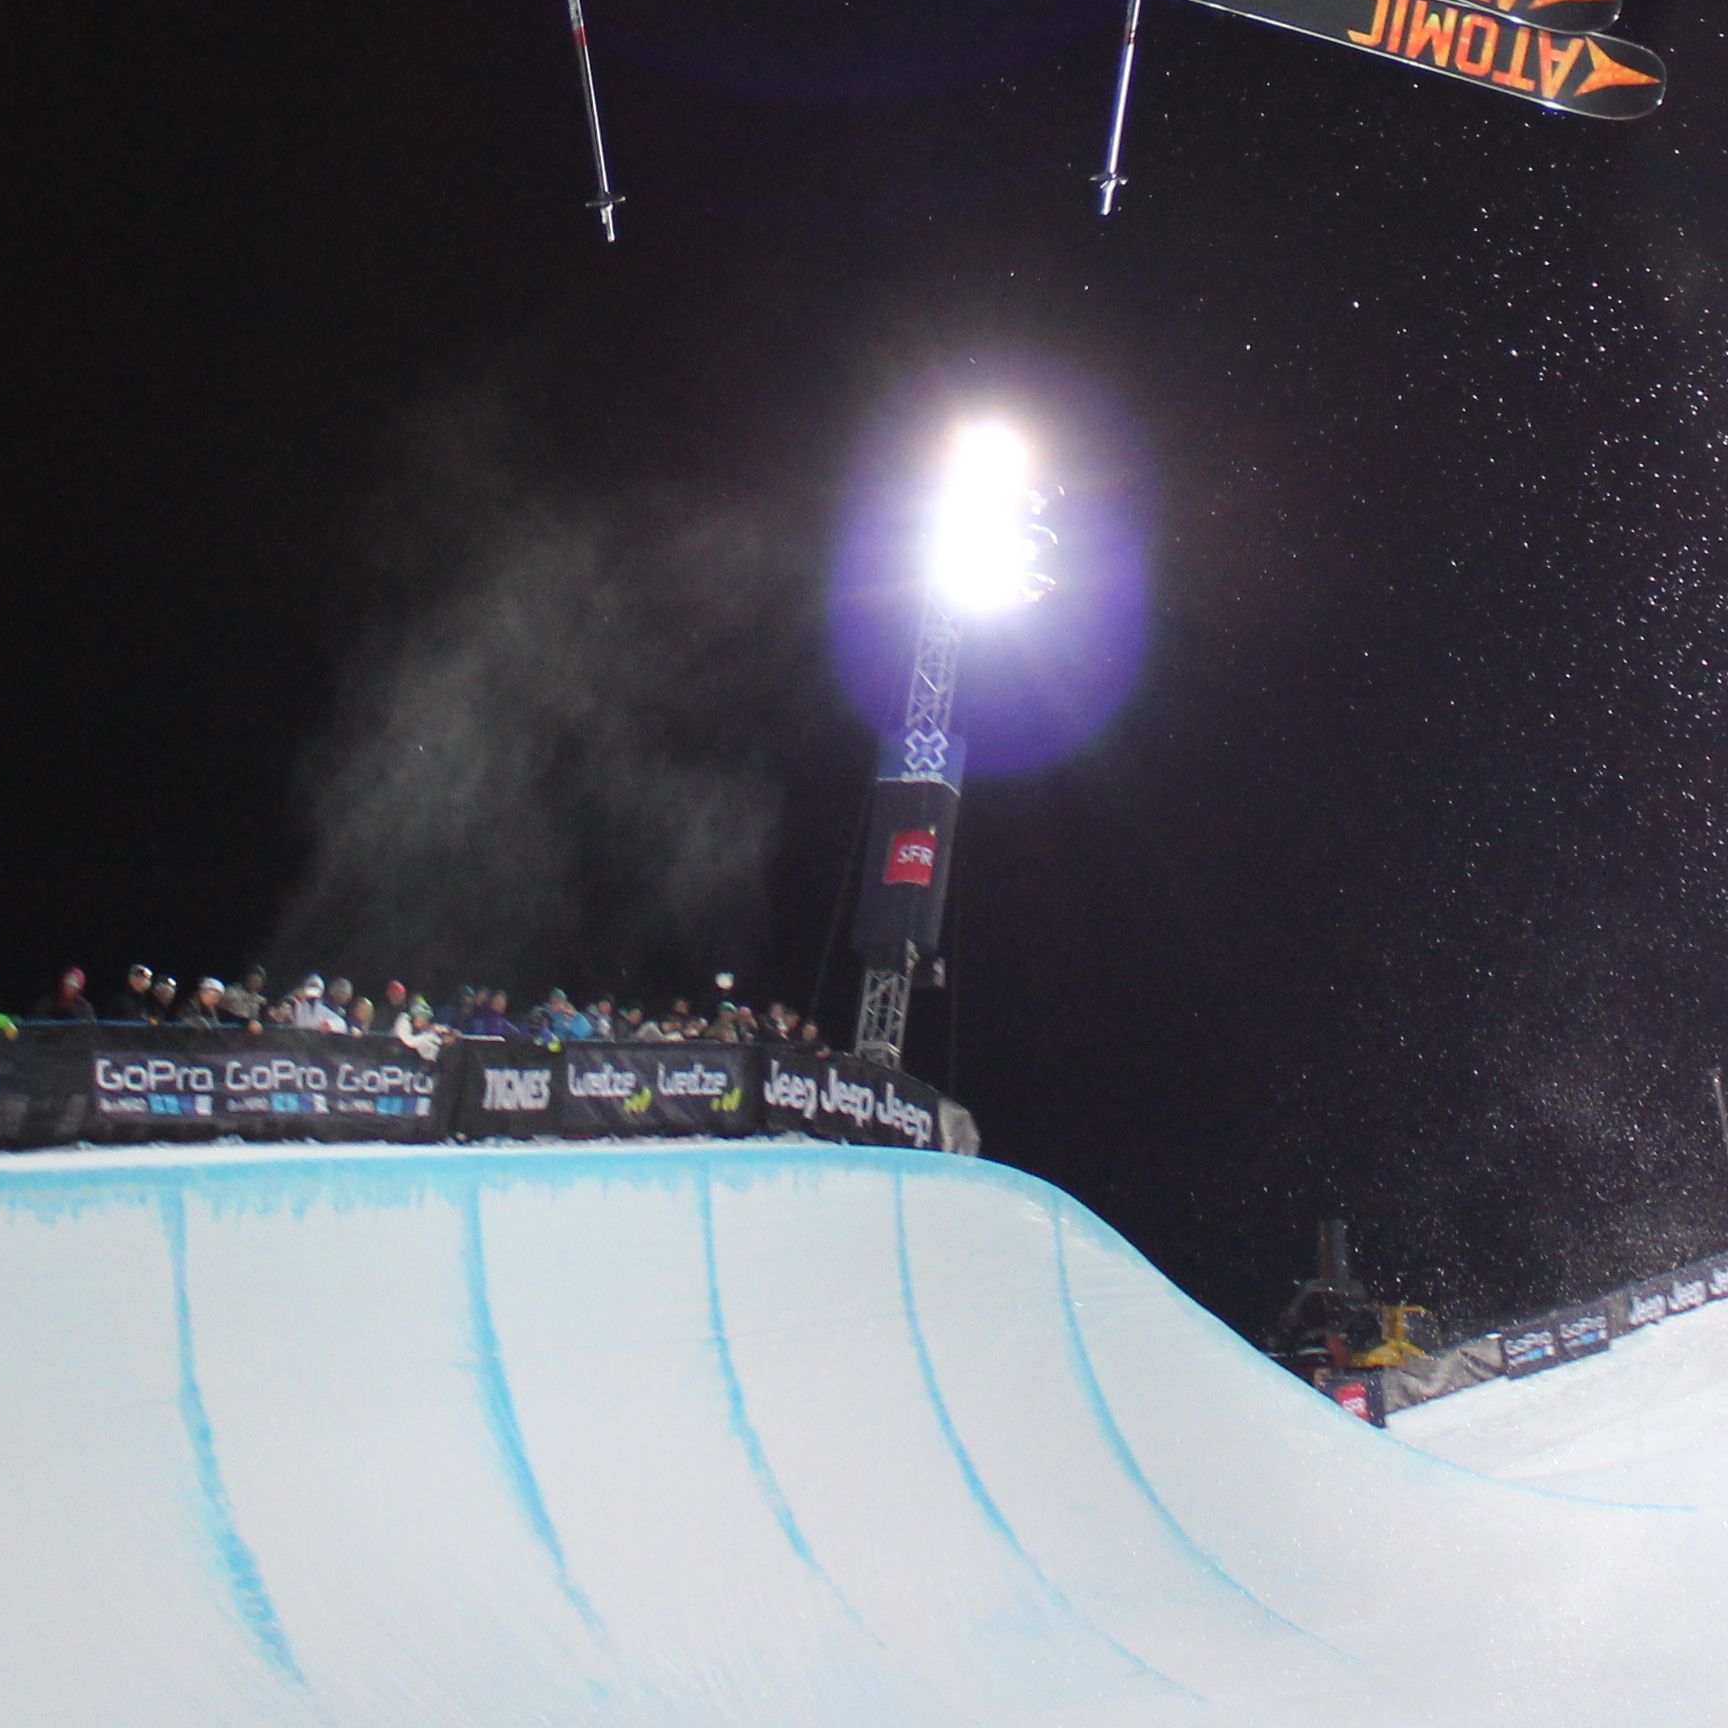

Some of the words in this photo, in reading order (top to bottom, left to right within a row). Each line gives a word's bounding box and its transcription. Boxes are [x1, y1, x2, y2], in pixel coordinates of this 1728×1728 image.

[897, 843, 936, 868] SFR
[95, 1058, 214, 1092] GoPro
[225, 1058, 328, 1092] GoPro
[336, 1062, 434, 1094] GoPro
[763, 1058, 818, 1121] Jeep
[819, 1067, 876, 1128] Jeep
[875, 1081, 934, 1149] Jeep
